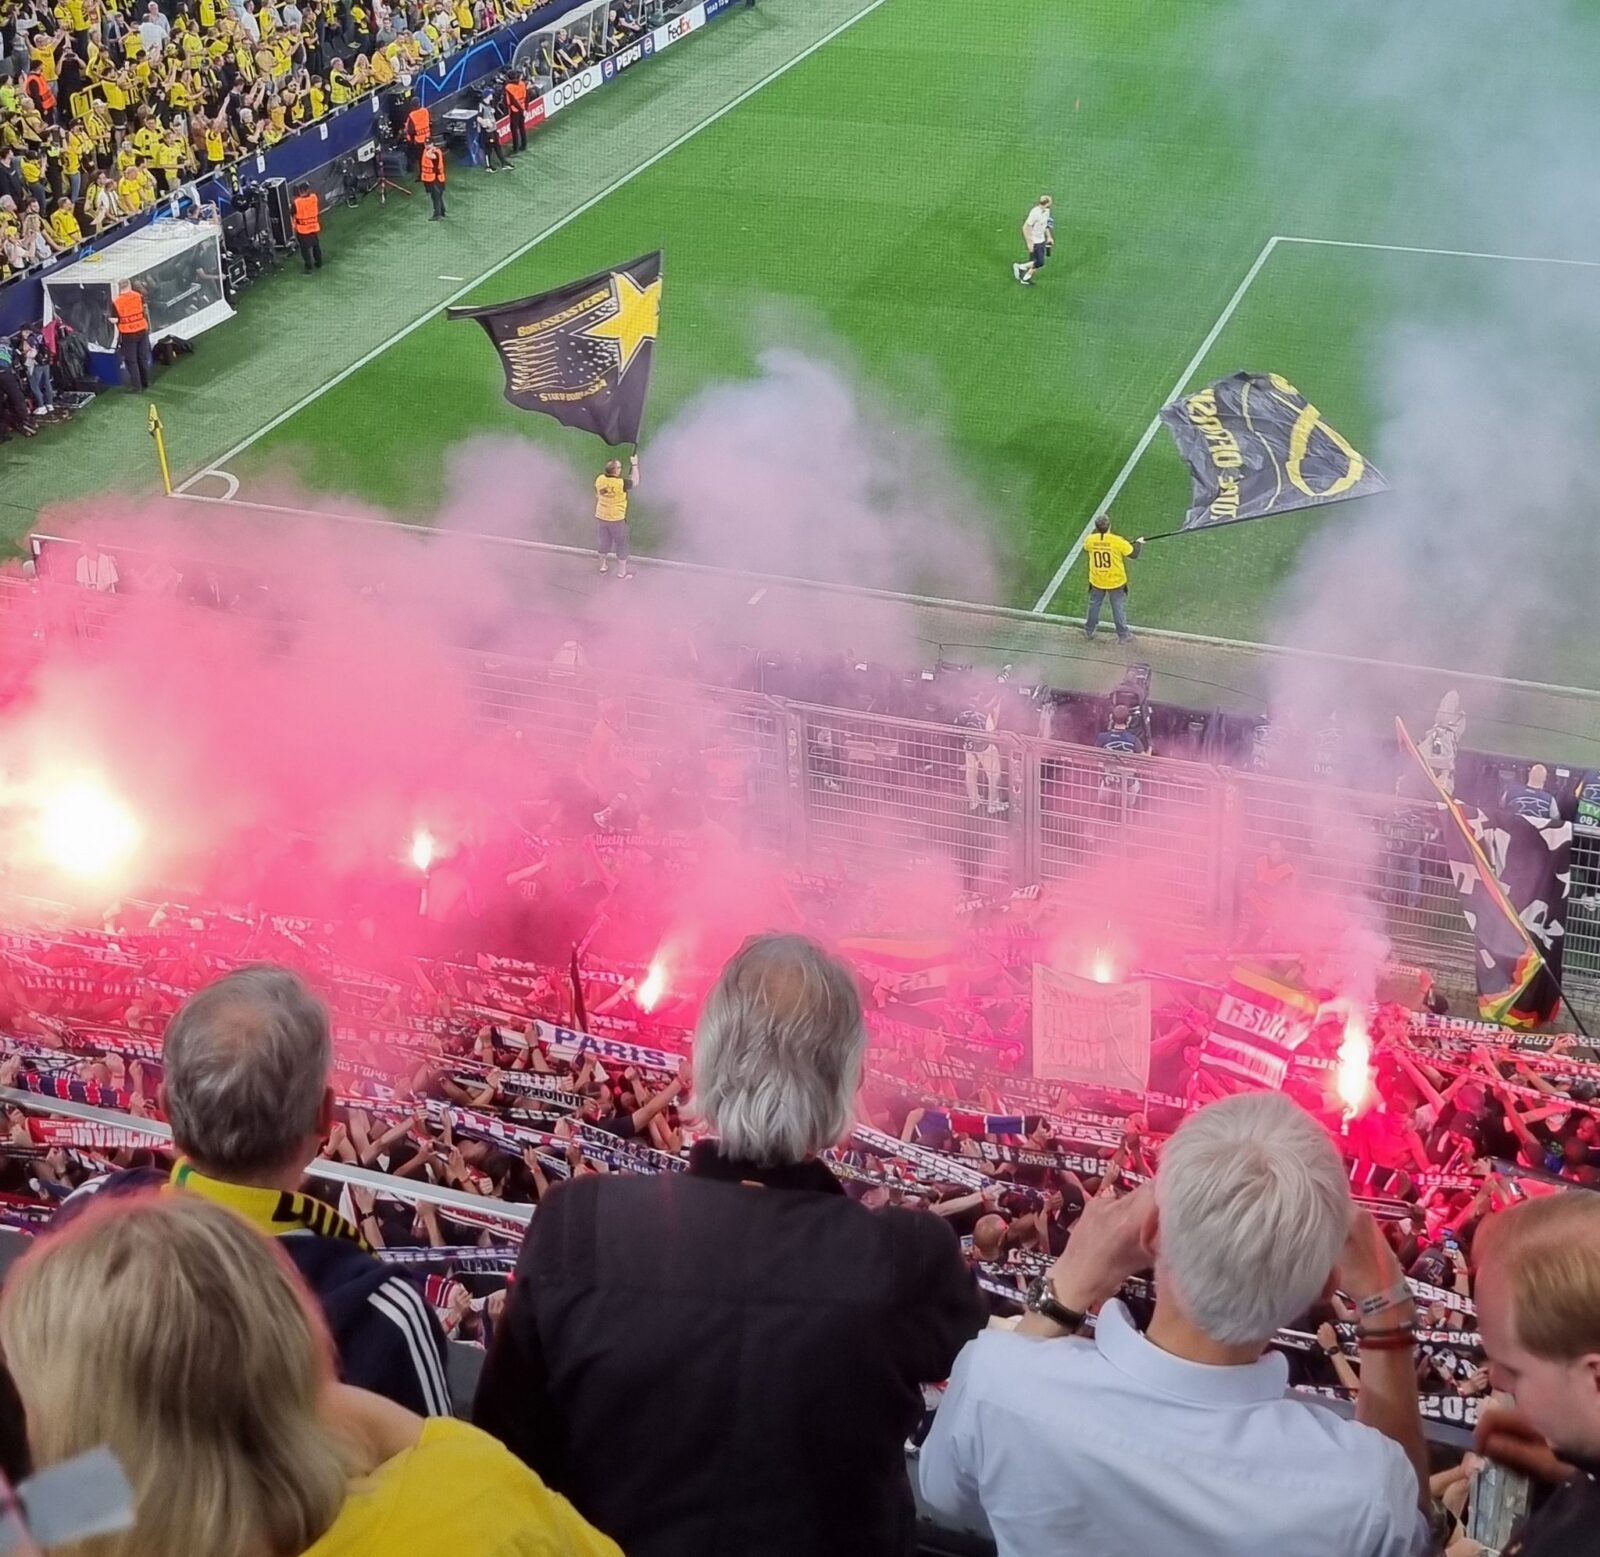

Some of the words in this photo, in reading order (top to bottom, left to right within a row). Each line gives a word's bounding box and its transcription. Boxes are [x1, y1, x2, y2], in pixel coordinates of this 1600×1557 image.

[667, 16, 692, 42] FedEx
[616, 44, 641, 71] PEPSI
[553, 72, 592, 106] oppo
[1093, 550, 1111, 569] 09
[1580, 815, 1599, 828] 082
[1585, 804, 1600, 816] TV
[554, 1027, 667, 1067] PARIS
[1064, 1154, 1108, 1177] 202
[1418, 1395, 1480, 1425] 202
